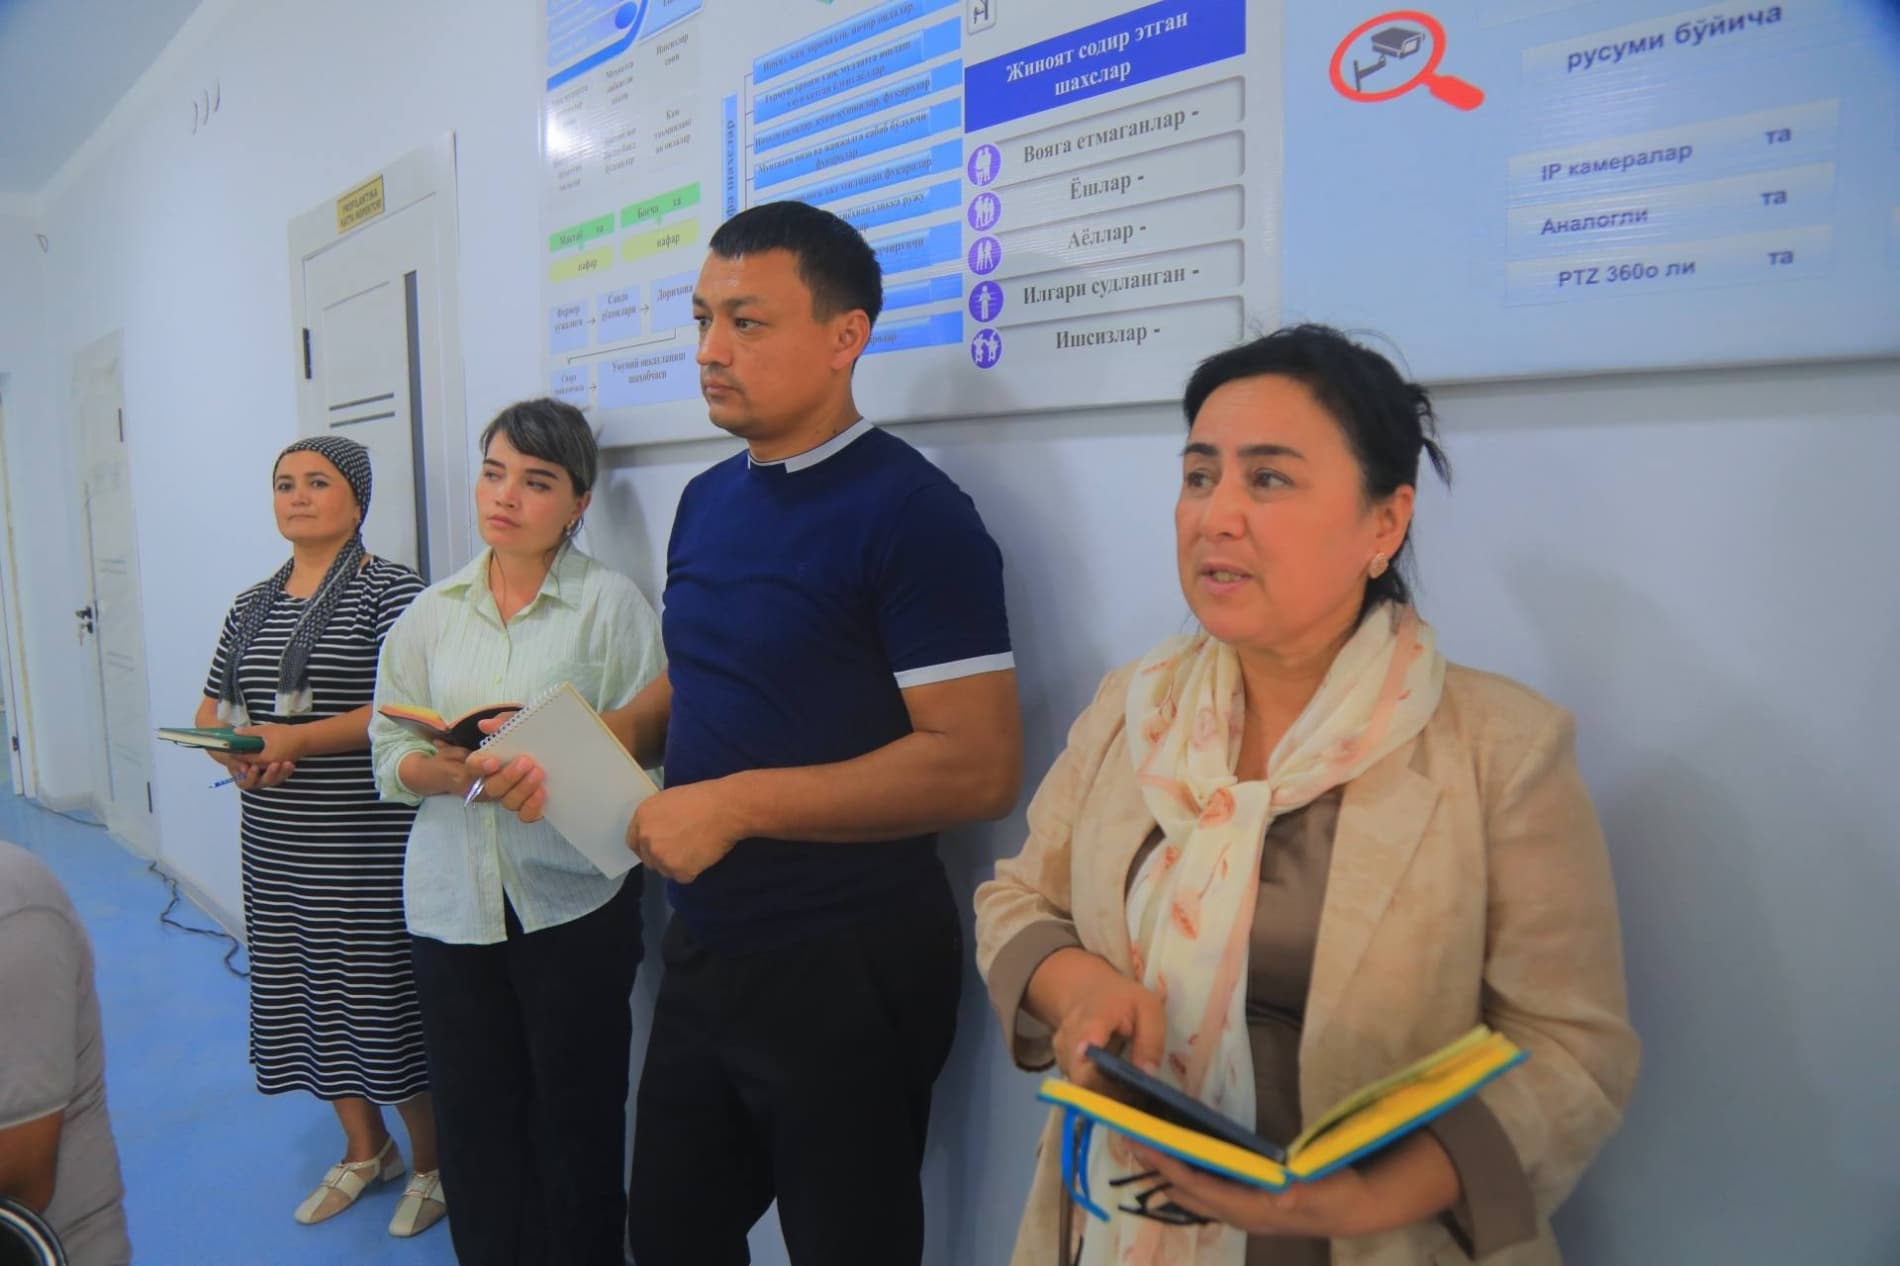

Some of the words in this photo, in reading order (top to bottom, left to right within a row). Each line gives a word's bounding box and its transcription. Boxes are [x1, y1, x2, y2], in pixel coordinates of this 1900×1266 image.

[1006, 51, 1075, 83] Жиноят
[1078, 31, 1131, 60] содир
[1134, 11, 1188, 42] этган
[1567, 31, 1666, 73] русуми
[1673, 4, 1783, 46] бўйича
[1054, 60, 1132, 96] шахслар
[1023, 139, 1072, 164] Вояга
[1076, 111, 1186, 152] етмаганлар
[1541, 162, 1561, 182] IP
[1567, 143, 1694, 177] камералар
[1763, 126, 1793, 145] та
[1070, 172, 1132, 200] Ёшлар
[1540, 208, 1649, 238] Аналогли
[1760, 187, 1788, 206] та
[1067, 223, 1134, 250] Аёллар
[1023, 280, 1087, 306] Илгари
[1091, 266, 1187, 298] судланган
[1558, 268, 1600, 288] PTZ
[1664, 261, 1697, 278] ли
[1767, 247, 1795, 266] та
[1056, 323, 1148, 350] Ишсизлар
